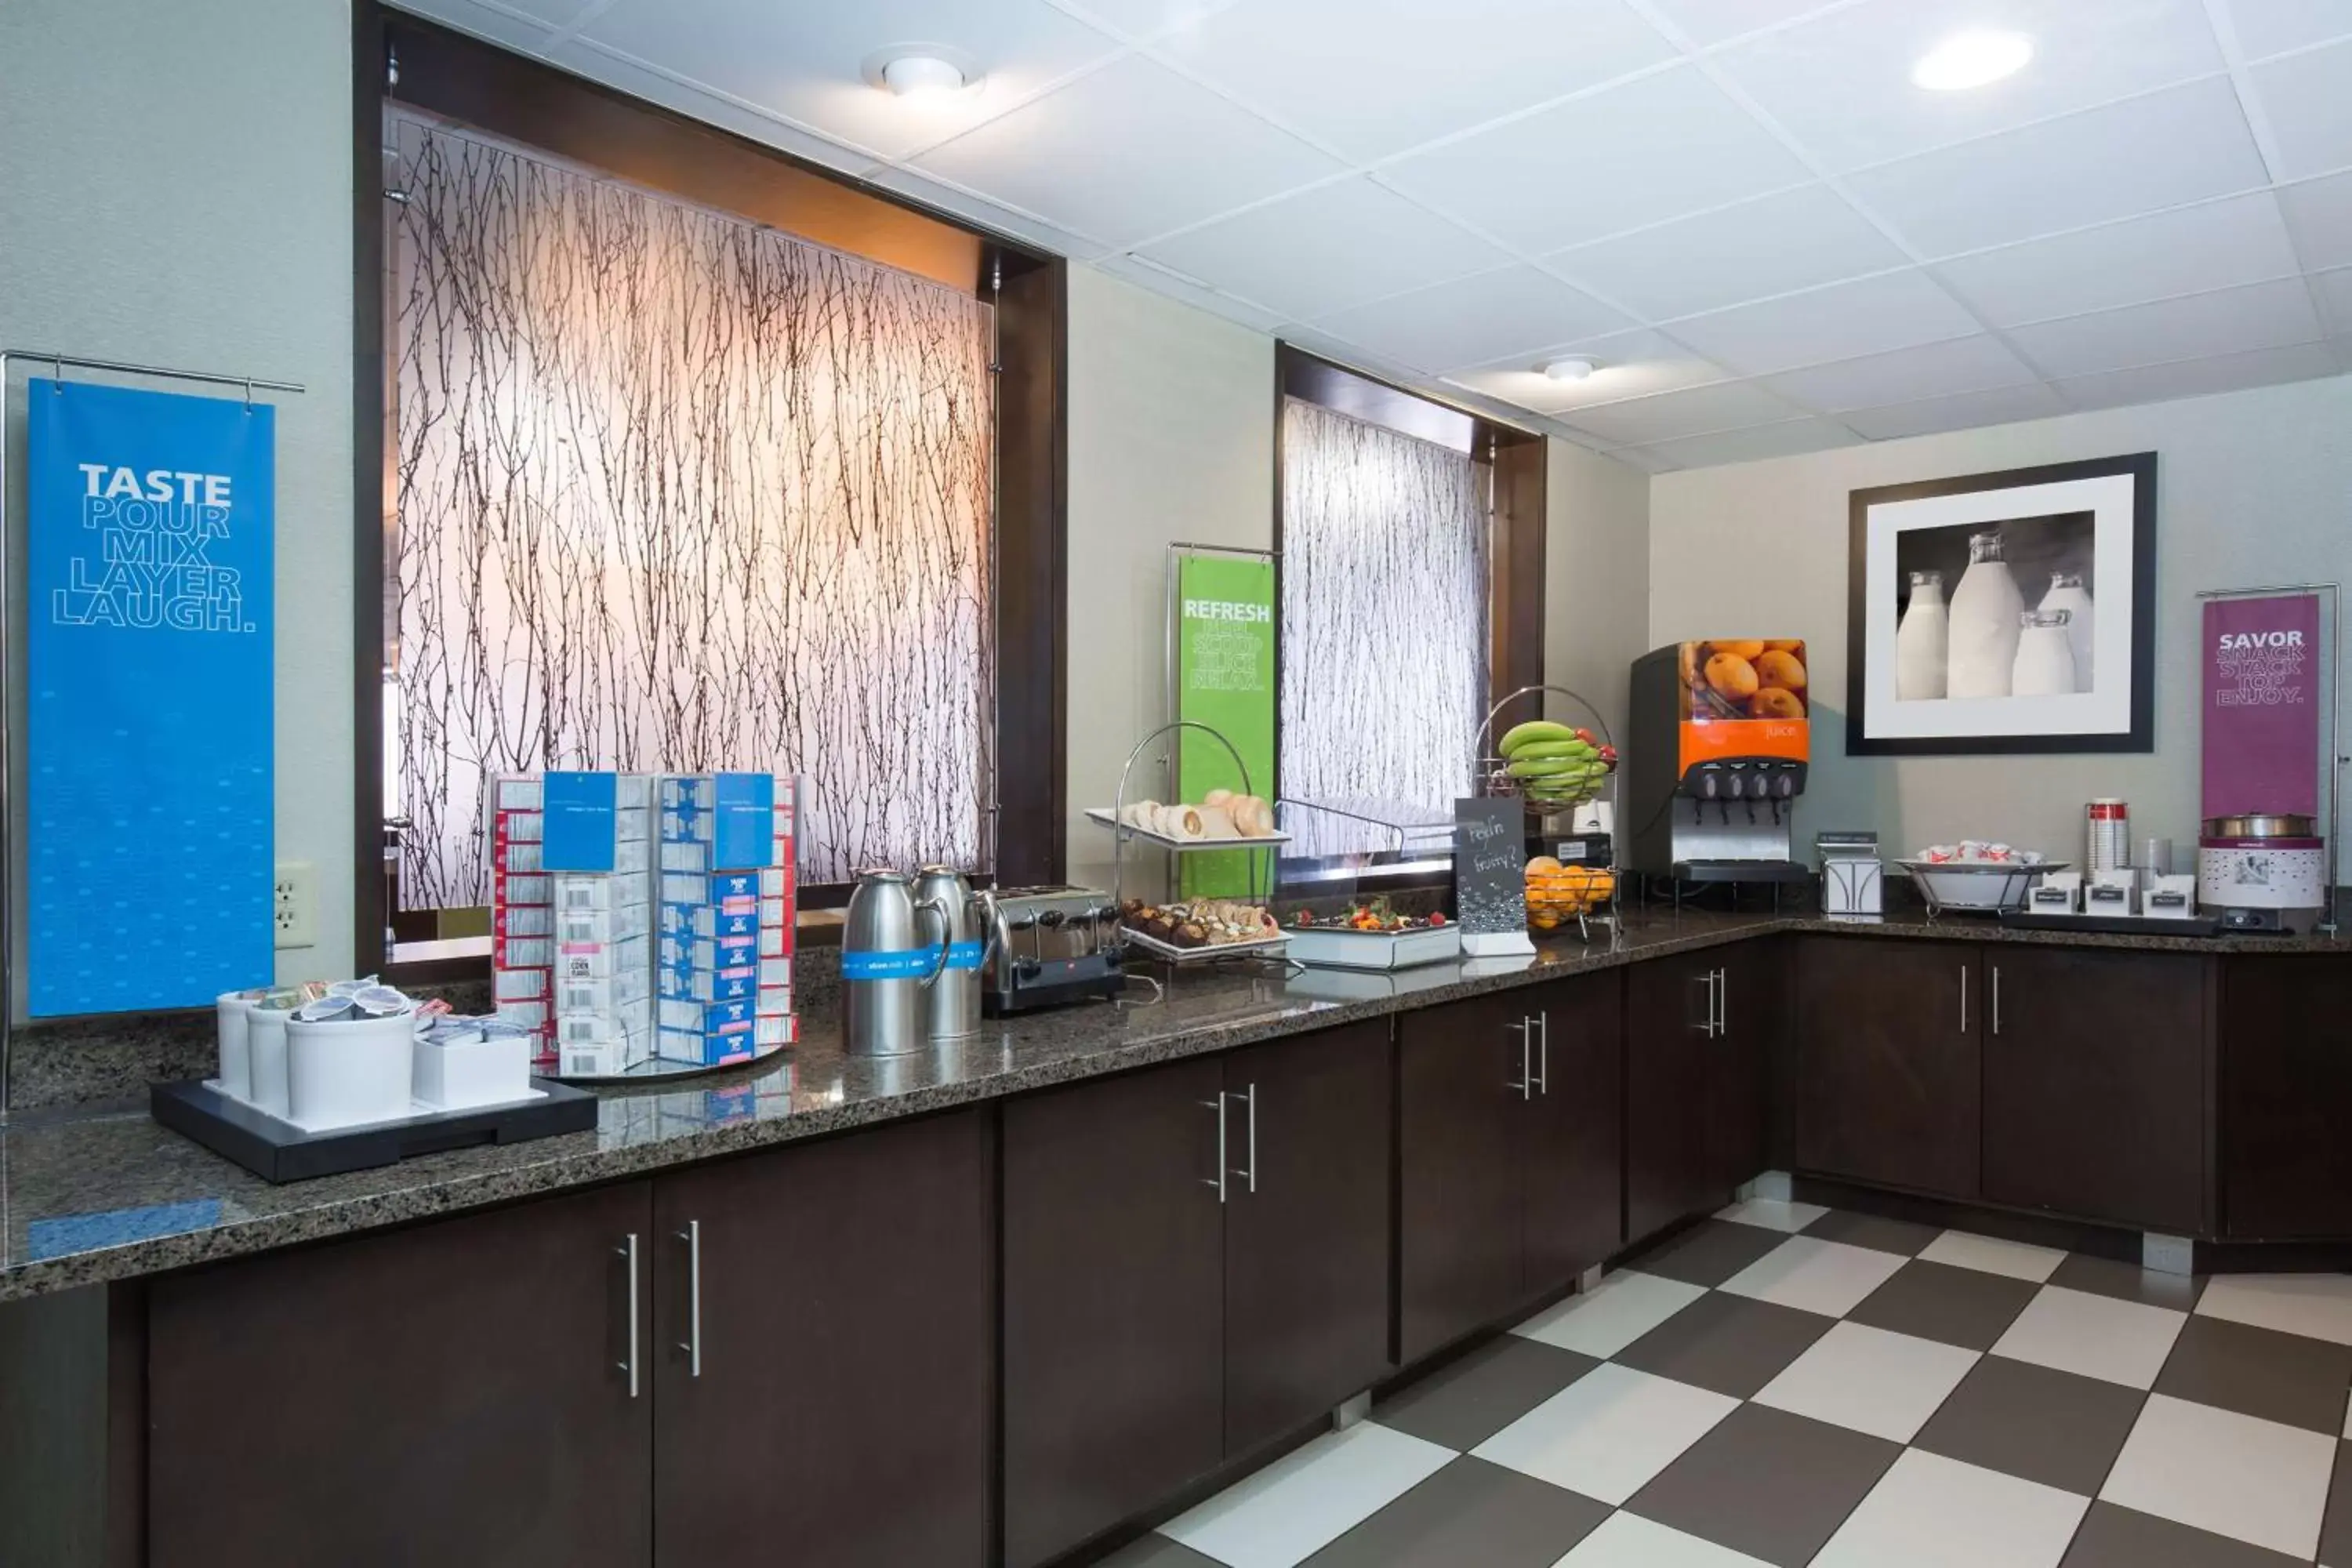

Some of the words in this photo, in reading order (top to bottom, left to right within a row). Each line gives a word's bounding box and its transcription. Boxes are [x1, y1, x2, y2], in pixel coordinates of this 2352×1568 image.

[78, 463, 232, 508] TASTE
[82, 493, 231, 539] POUR
[103, 528, 211, 567] MIX
[70, 557, 243, 601] LAYER
[53, 589, 256, 633] LAUGH.
[1185, 599, 1270, 623] REFRESH
[2216, 643, 2309, 665] SNACK
[2220, 630, 2303, 650] SAVOR
[2219, 659, 2303, 678] STACK
[2216, 686, 2304, 706] ENJOY.
